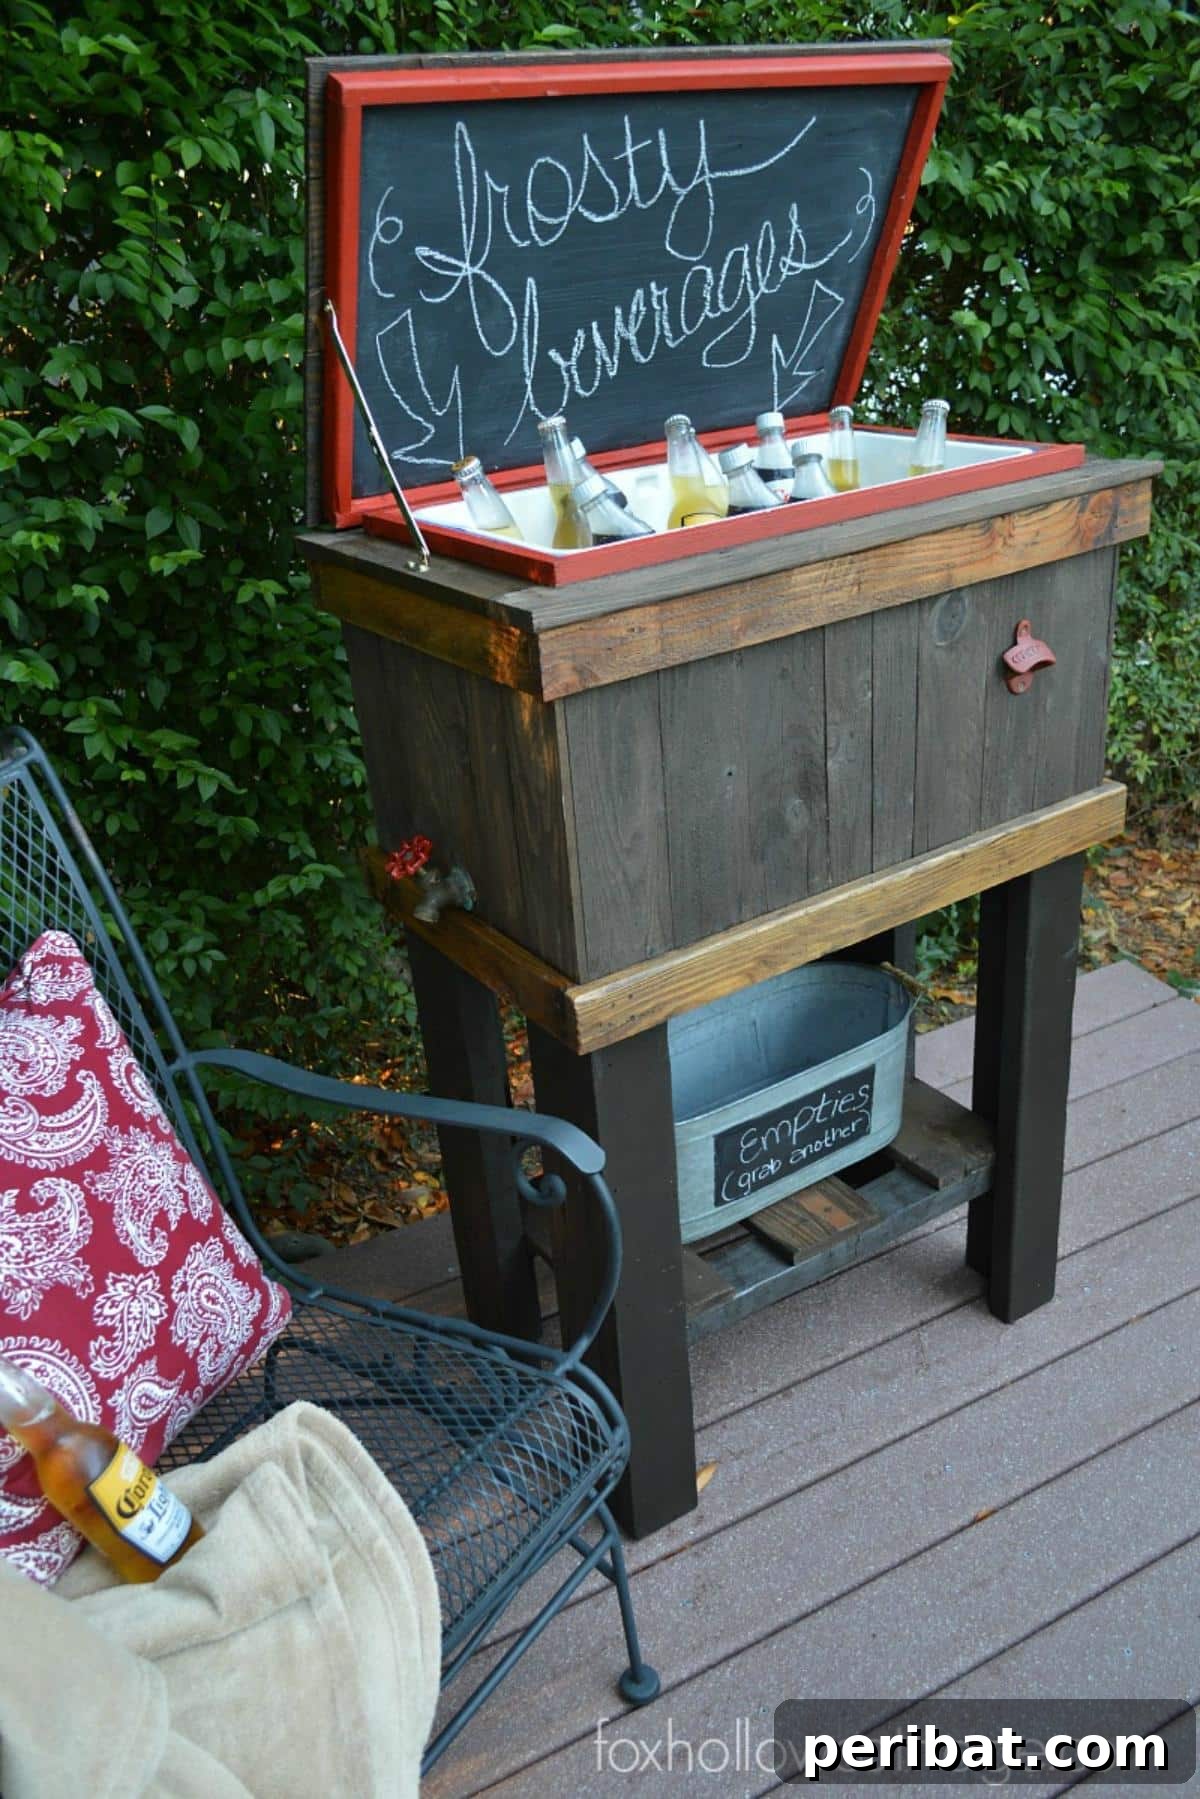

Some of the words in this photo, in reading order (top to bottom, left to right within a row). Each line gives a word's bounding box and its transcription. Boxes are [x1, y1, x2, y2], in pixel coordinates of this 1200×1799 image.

[415, 114, 817, 356] frosty
[504, 202, 853, 446] beverages
[739, 1083, 870, 1165] Empties
